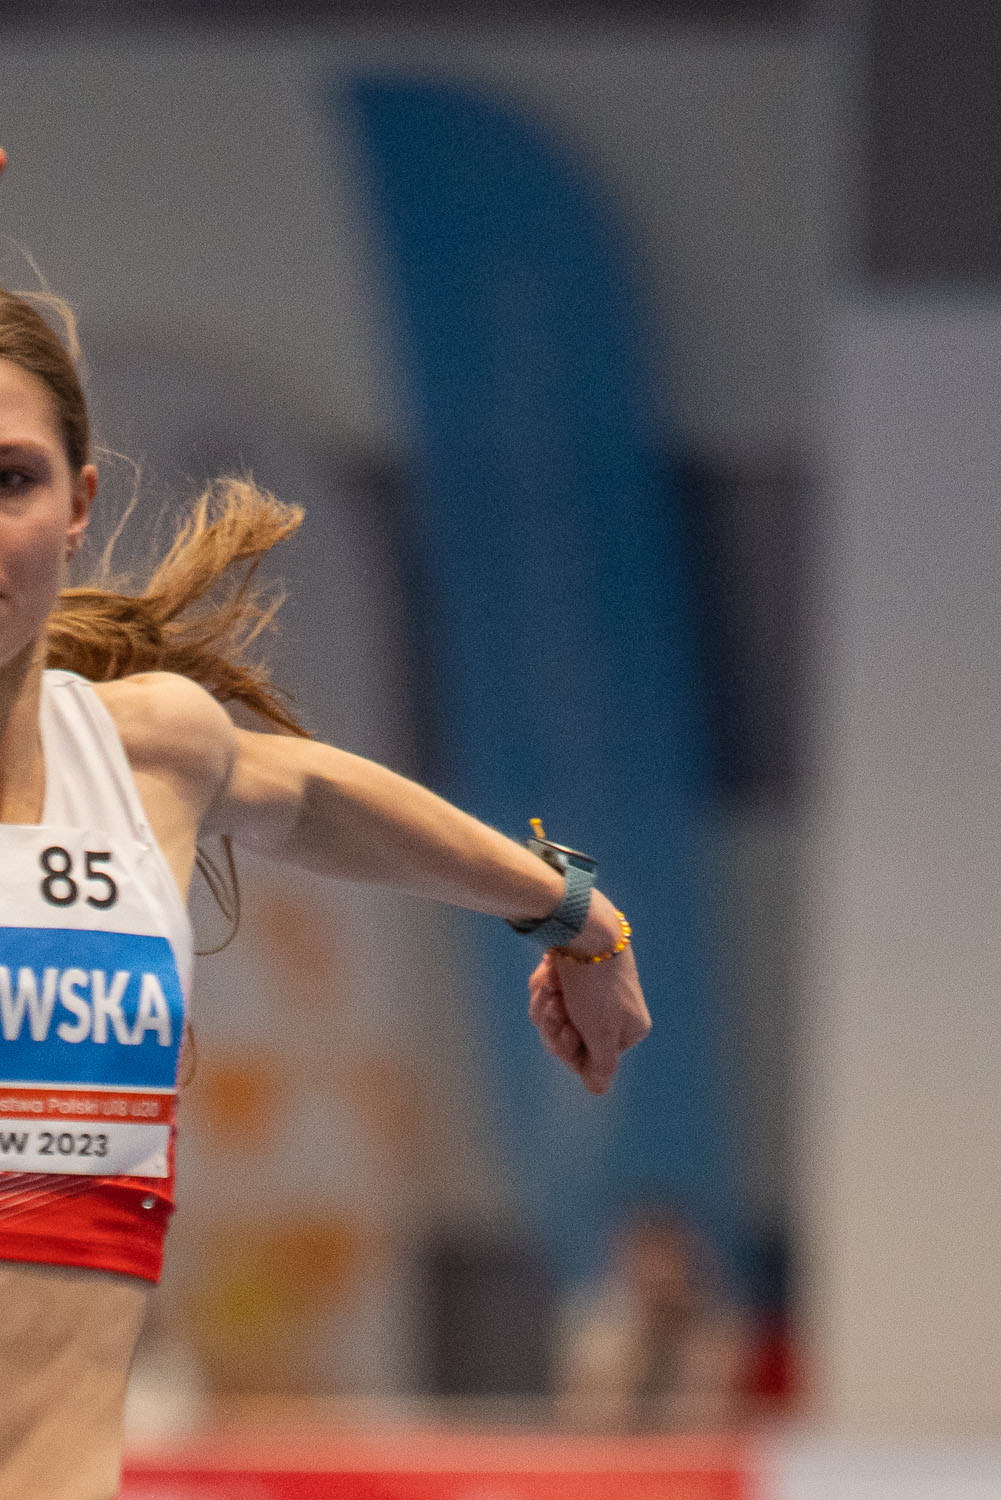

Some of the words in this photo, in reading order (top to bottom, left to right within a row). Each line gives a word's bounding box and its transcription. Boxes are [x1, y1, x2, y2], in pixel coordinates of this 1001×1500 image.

[39, 846, 119, 910] 85
[48, 1097, 98, 1115] Polski
[38, 1131, 109, 1158] 2023
